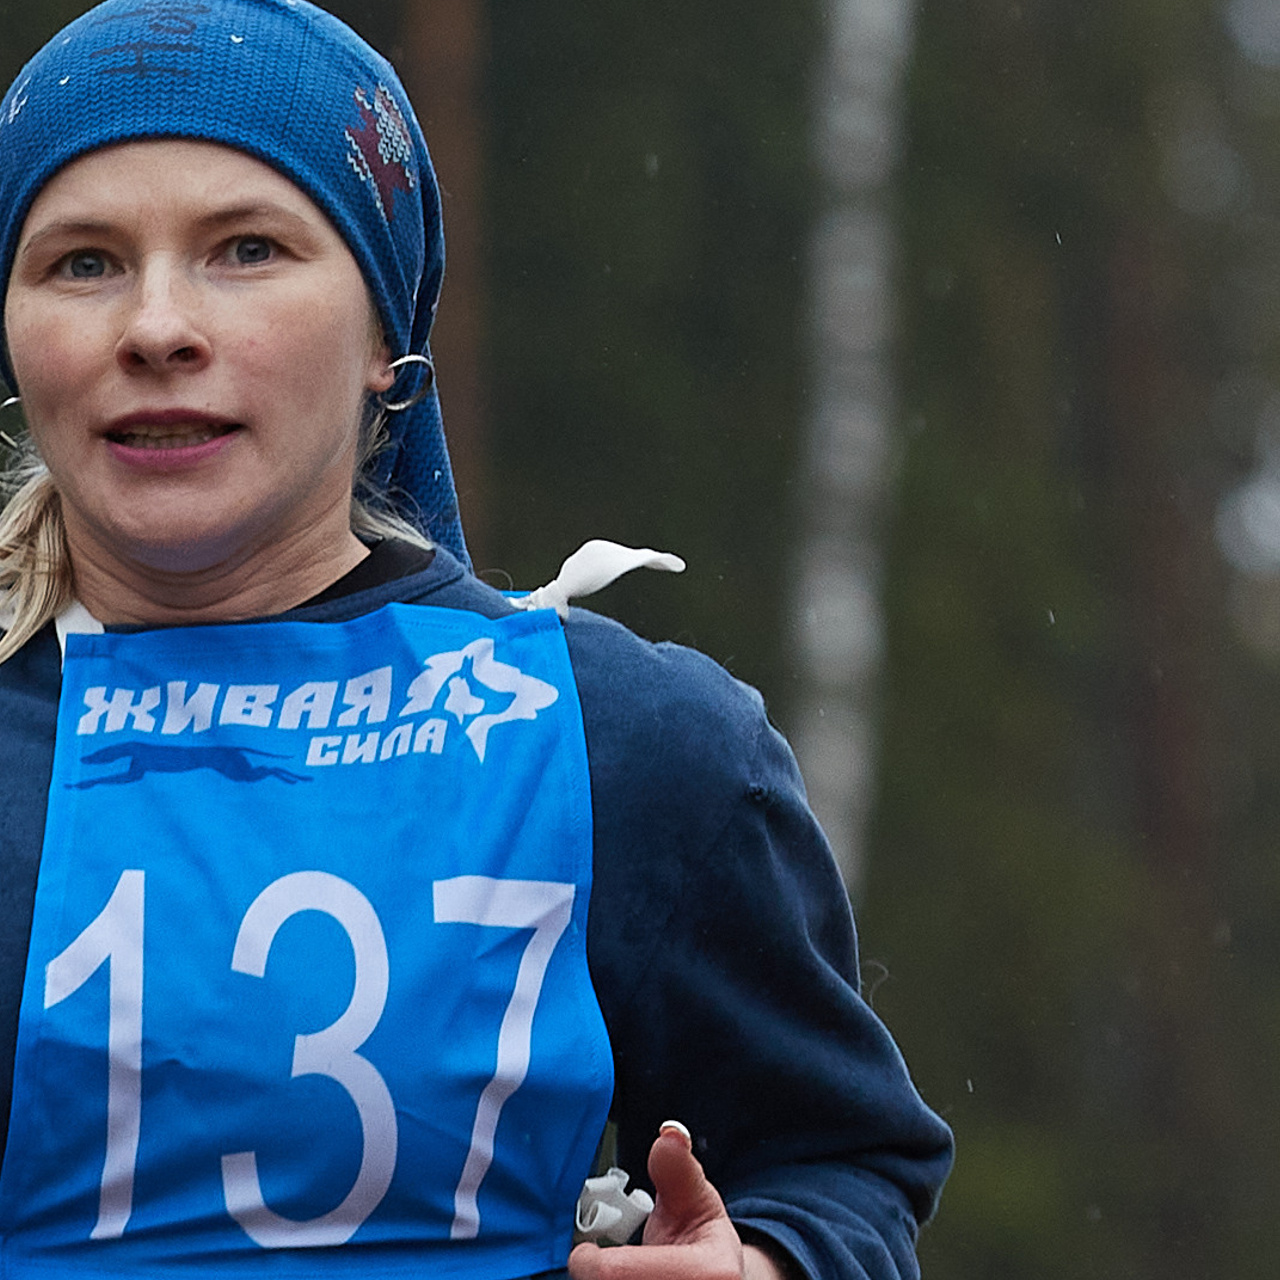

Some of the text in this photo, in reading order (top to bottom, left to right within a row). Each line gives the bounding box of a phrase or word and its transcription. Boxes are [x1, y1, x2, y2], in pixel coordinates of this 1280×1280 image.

[77, 666, 392, 735] ЖИВАЯ
[305, 718, 448, 767] СИЛА
[44, 869, 577, 1248] 137
